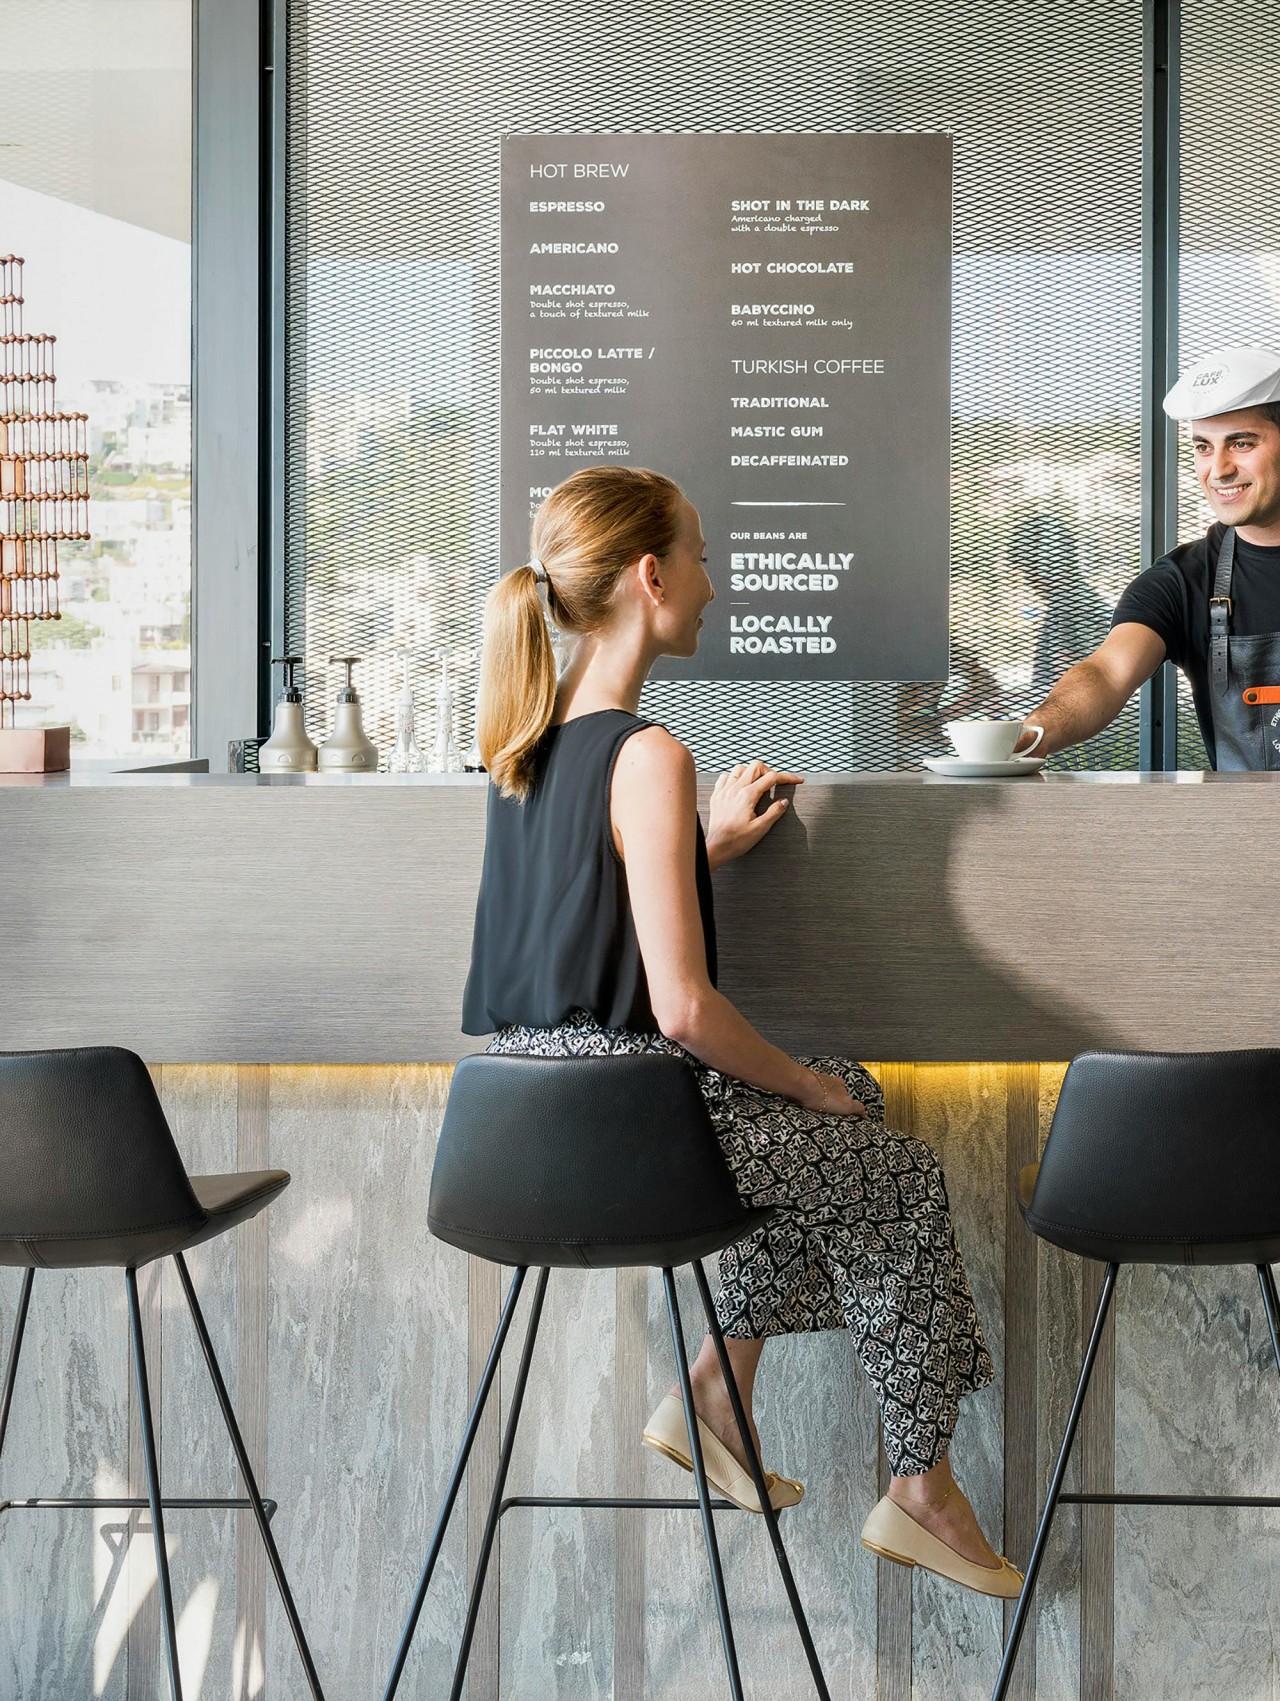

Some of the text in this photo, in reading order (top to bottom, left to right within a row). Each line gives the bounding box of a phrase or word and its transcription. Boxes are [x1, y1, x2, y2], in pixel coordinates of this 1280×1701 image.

[530, 163, 630, 179] HOT BREW
[529, 200, 606, 213] ESPRESSO
[731, 199, 870, 212] SHOT IN THE DARK
[730, 213, 823, 226] Americano charged
[730, 222, 840, 235] with double espresso
[529, 242, 619, 255] AMERICANO
[731, 262, 854, 274] HOT CHOCOLATE
[529, 284, 616, 296] MACCHIATO
[529, 299, 630, 311] Double shot espresso,
[731, 303, 815, 316] BABYCCINO
[539, 308, 650, 320] touch of textured milk
[746, 318, 760, 327] ml
[762, 317, 803, 327] textured
[805, 318, 829, 327] milk
[831, 318, 853, 330] only
[529, 347, 643, 360] PICCOLO LATTE
[529, 362, 583, 374] BONGO
[730, 359, 885, 374] TURKISH COFFEE
[529, 375, 630, 387] Double shot espresso,
[544, 386, 558, 394] ml
[560, 384, 602, 394] textured
[603, 385, 627, 394] milk
[730, 396, 830, 409] TRADITIONAL
[529, 424, 618, 436] FLAT WHITE
[730, 425, 824, 438] MASTIC GUM
[529, 437, 630, 450] Double shot espresso,
[529, 446, 631, 457] 110 ml textured milk
[730, 455, 849, 467] DECAFFEINATED
[730, 531, 808, 540] OUR BEANS ARE
[730, 552, 855, 571] ETHICALLY
[730, 573, 839, 592] SOURCED
[730, 615, 833, 633] LOCALLY
[729, 636, 838, 655] ROASTED
